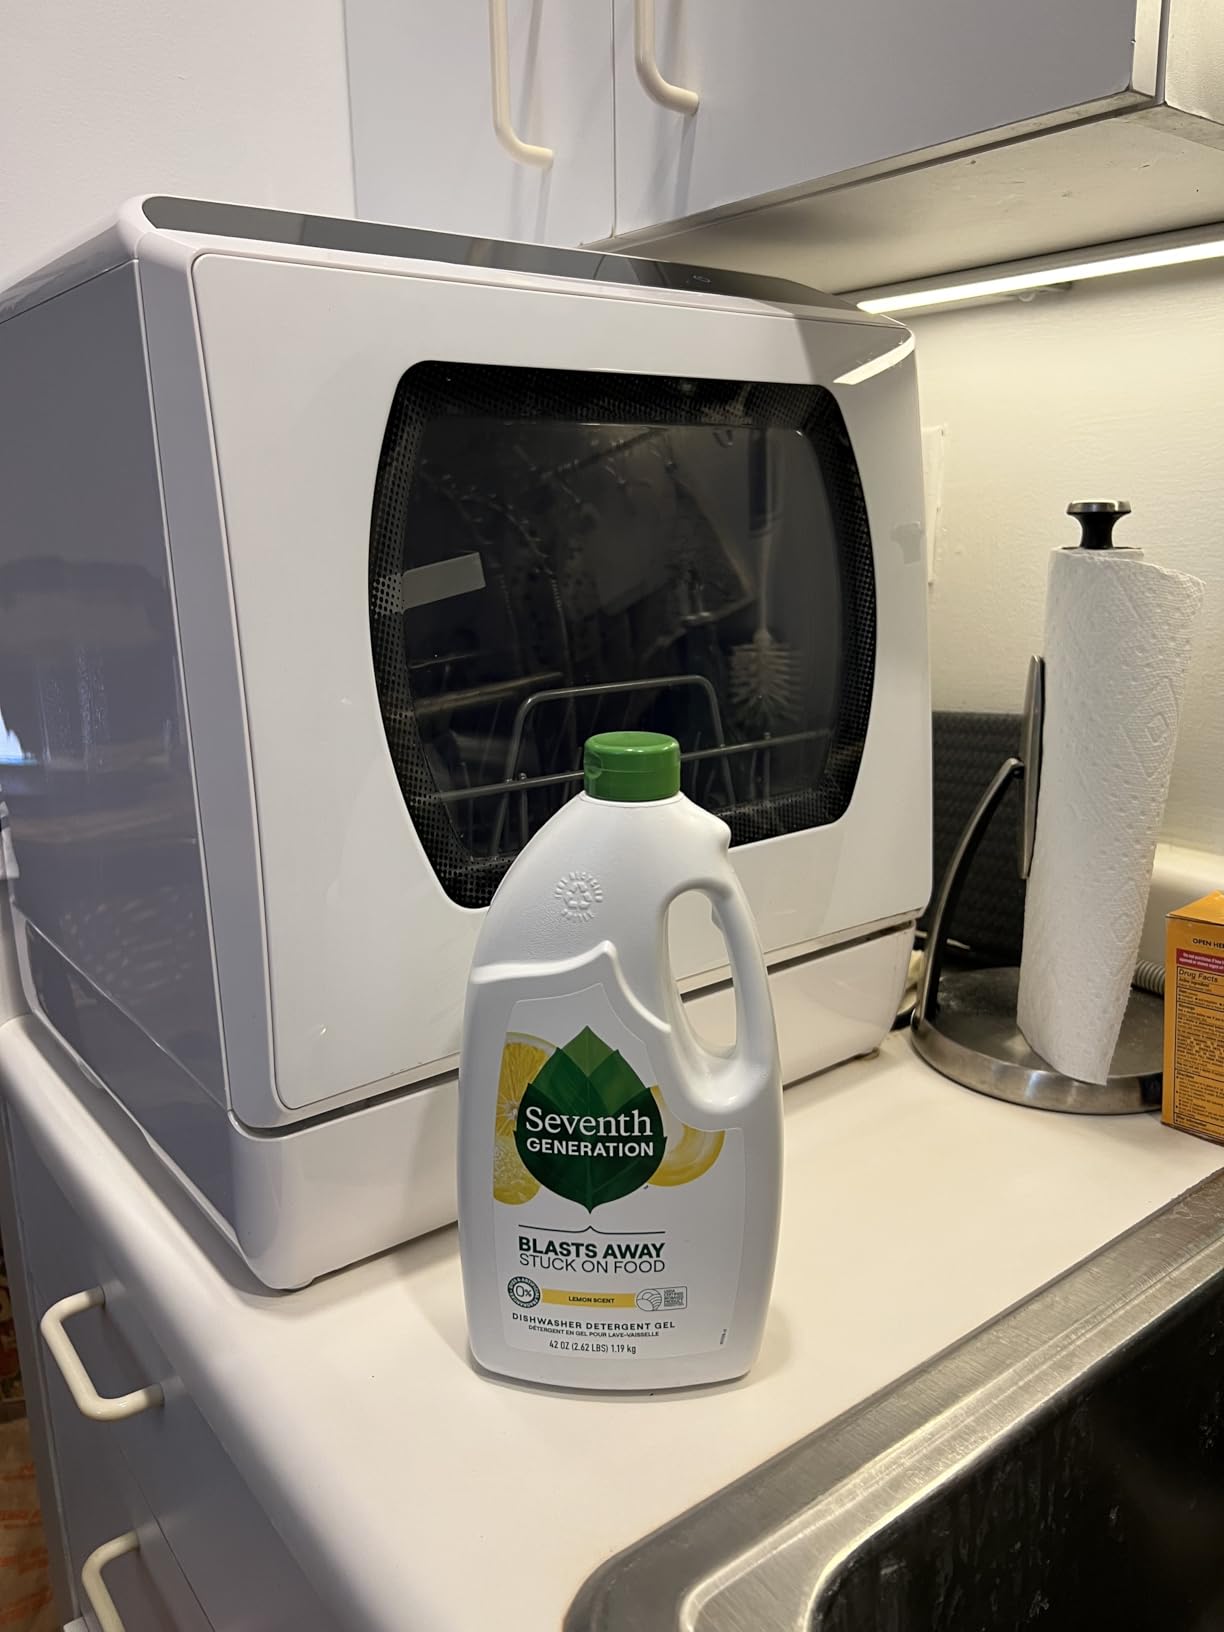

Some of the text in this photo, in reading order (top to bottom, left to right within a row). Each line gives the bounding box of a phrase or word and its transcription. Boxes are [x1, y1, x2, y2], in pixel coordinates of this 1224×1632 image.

[1192, 938, 1211, 946] OPEN
[1178, 969, 1218, 983] Drug Facts
[525, 1106, 653, 1136] Seventh
[526, 1138, 654, 1157] GENERATION
[518, 1235, 666, 1259] BLASTS AWAY
[519, 1252, 666, 1274] STUCK ON FOOD
[515, 1285, 532, 1297] 0%
[512, 1312, 675, 1331] DISHWASHER DETERGENT GEL
[528, 1324, 565, 1335] DÉTERGENT
[549, 1340, 637, 1354] 42 OZ (2.62 LBS) 1.19 kg
